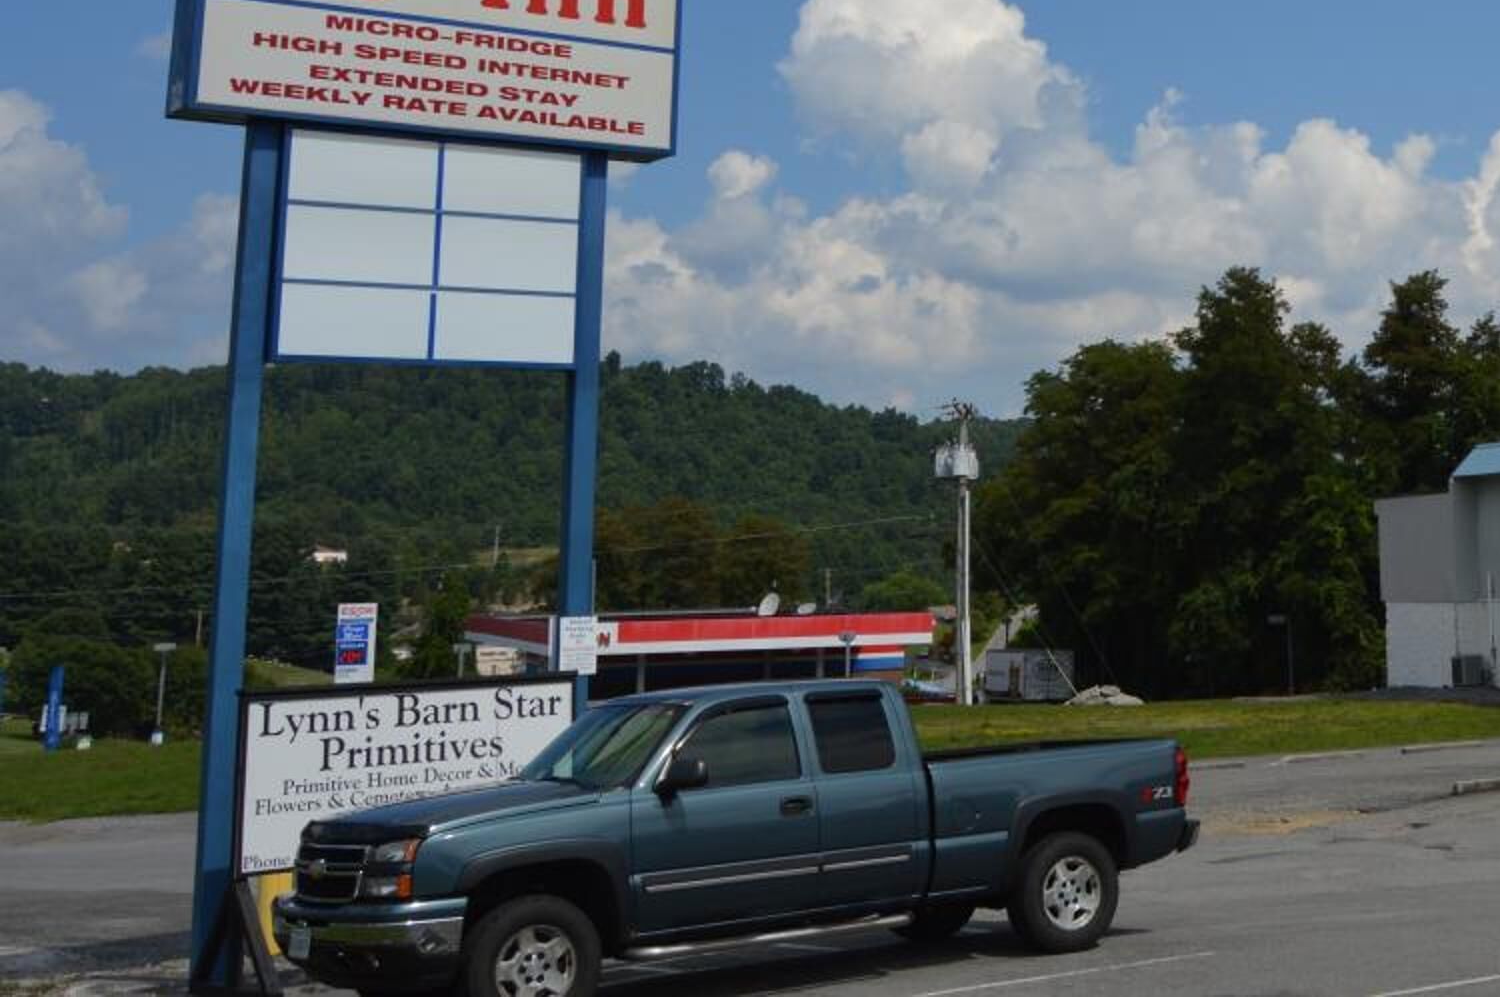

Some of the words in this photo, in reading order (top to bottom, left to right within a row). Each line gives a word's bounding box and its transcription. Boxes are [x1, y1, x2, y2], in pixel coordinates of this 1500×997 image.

[325, 14, 573, 59] MICRO-FRIDGE
[252, 32, 343, 56] HIGH
[354, 44, 467, 70] SPEED
[477, 58, 631, 90] INTERNET
[229, 77, 374, 107] WEEKLY
[382, 93, 468, 117] RATE
[477, 104, 646, 136] AVAILABLE
[308, 64, 489, 98] EXTENDED
[498, 85, 580, 108] STAY
[259, 695, 380, 745] Lynn's
[394, 693, 481, 728] Barn
[493, 685, 562, 721] Star
[319, 730, 504, 772] Primitives
[282, 776, 363, 796] Primitive
[367, 771, 418, 789] Home
[424, 766, 473, 784] Decor
[477, 762, 493, 779] &
[255, 798, 321, 816] Flowers
[327, 793, 345, 809] &
